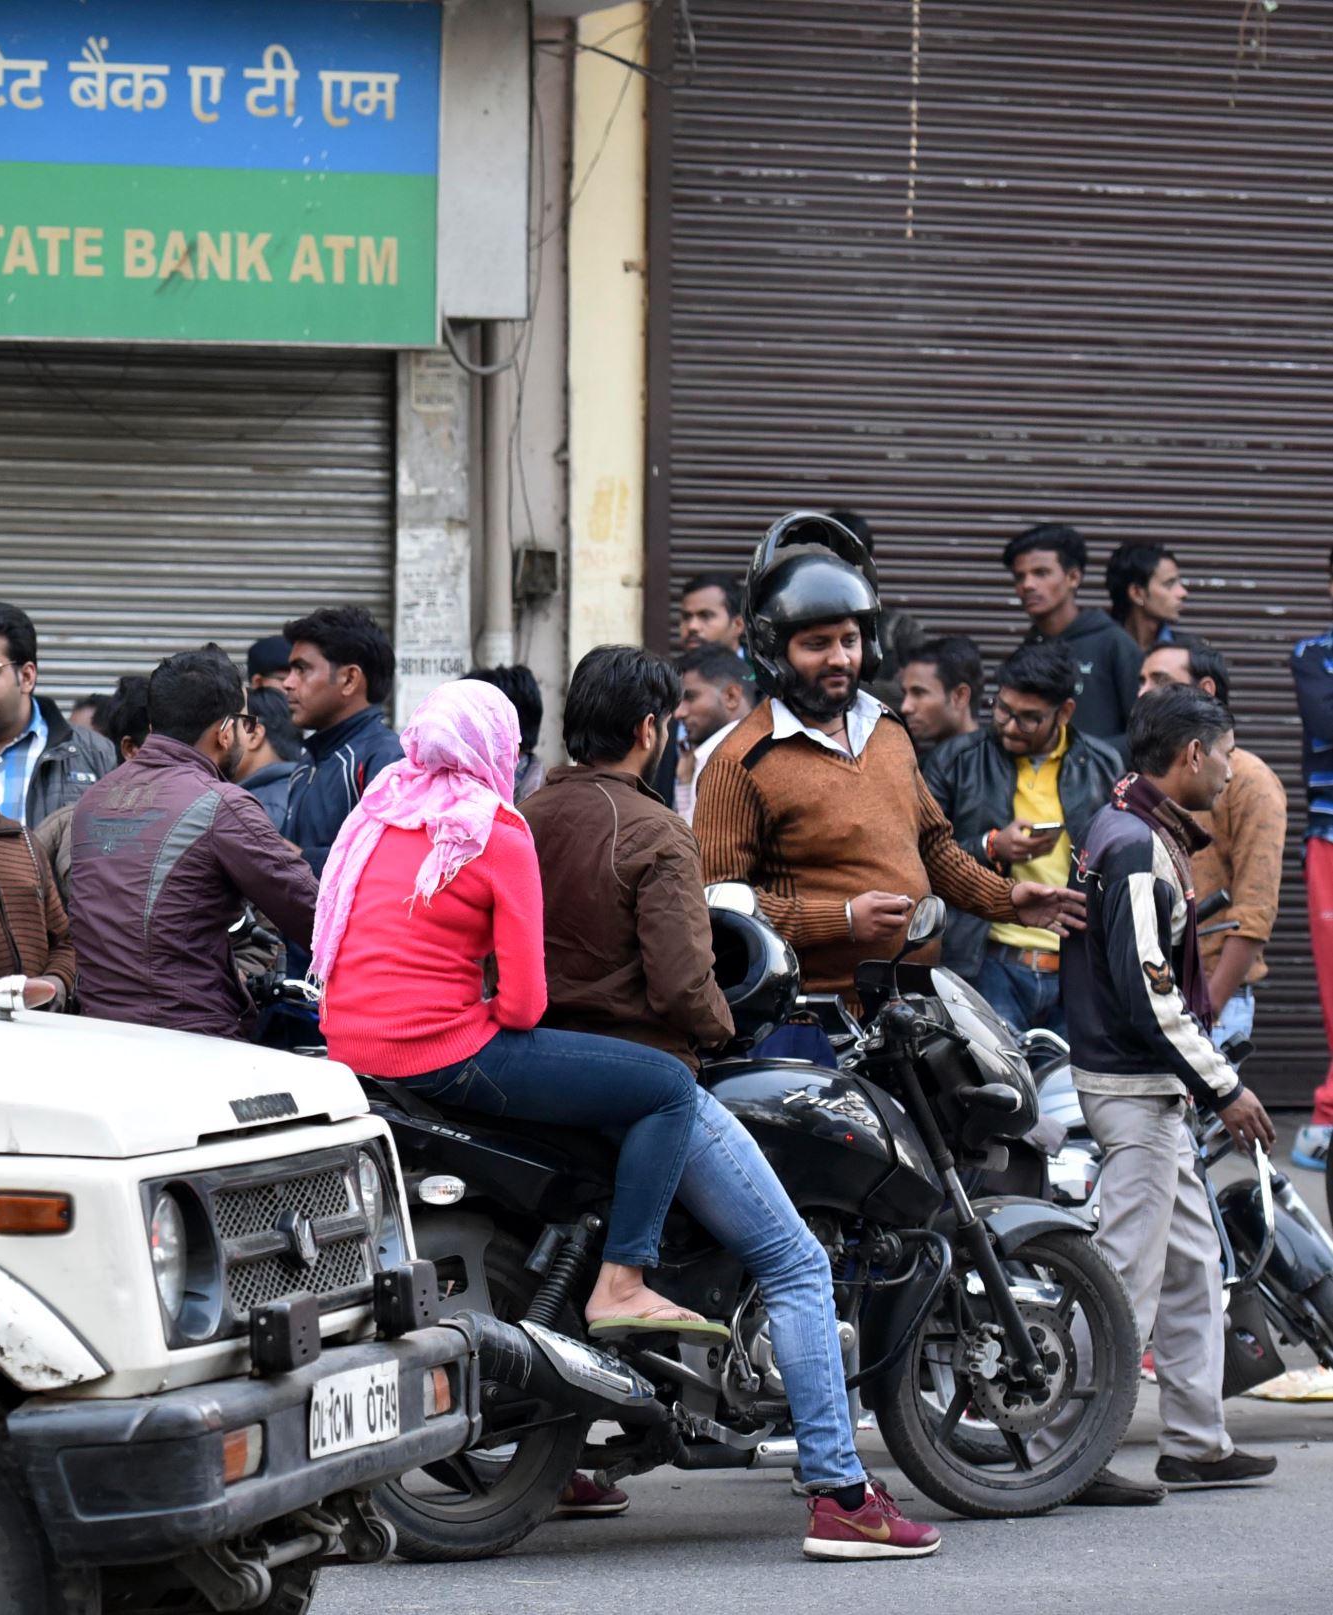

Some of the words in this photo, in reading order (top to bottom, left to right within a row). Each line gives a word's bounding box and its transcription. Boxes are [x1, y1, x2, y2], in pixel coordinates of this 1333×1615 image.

[68, 36, 170, 111] बैंक
[187, 65, 226, 123] ए
[243, 43, 300, 117] टी
[318, 70, 400, 127] एम
[123, 228, 273, 282] BANK
[288, 234, 399, 286] ATM
[431, 1125, 472, 1141] 150
